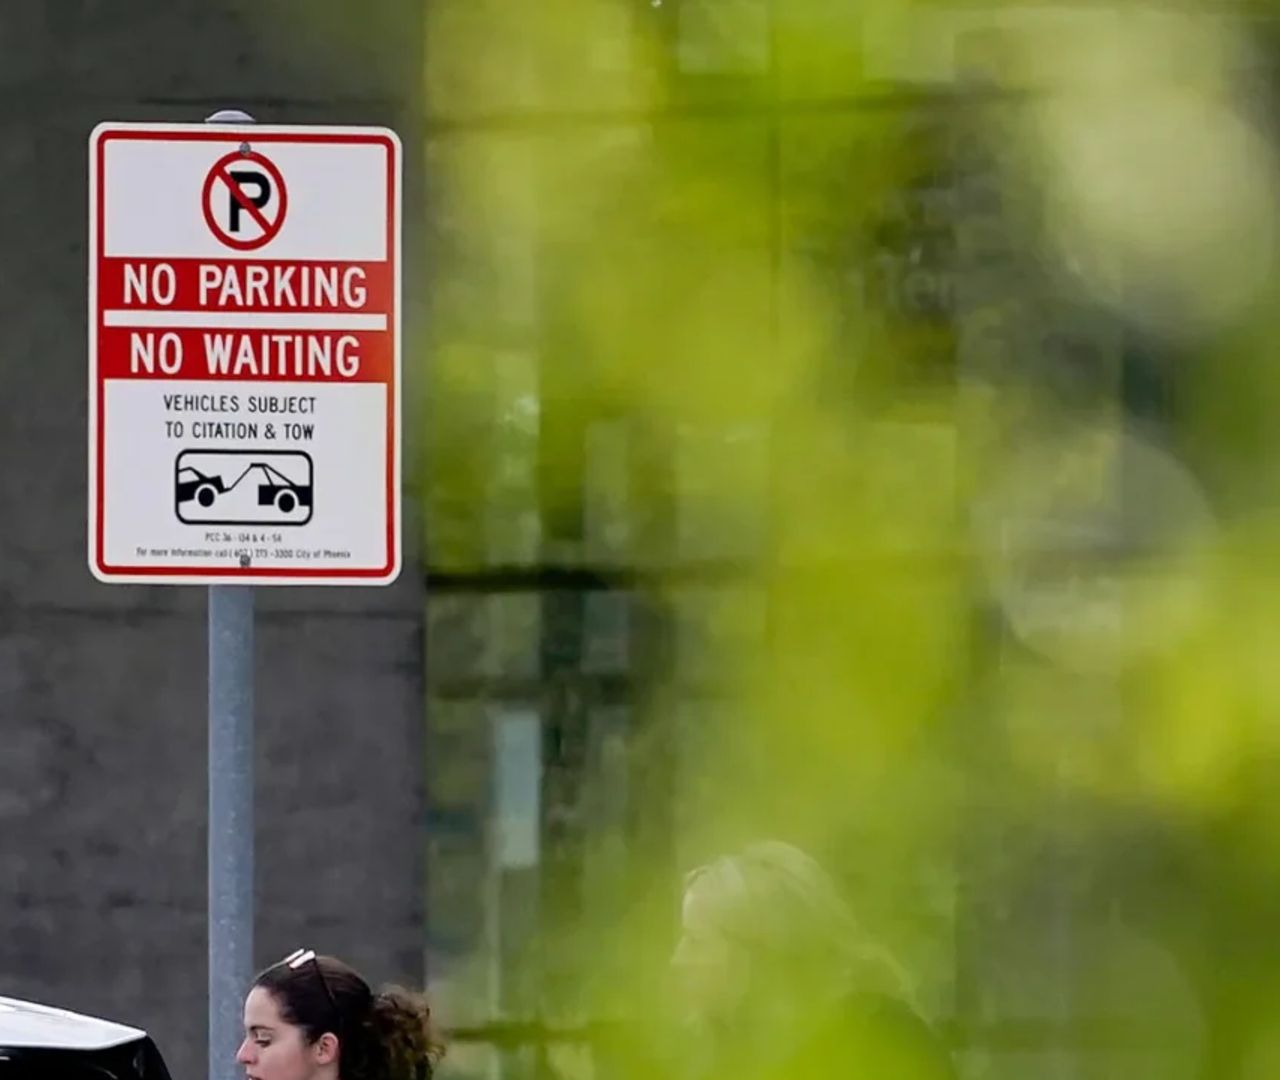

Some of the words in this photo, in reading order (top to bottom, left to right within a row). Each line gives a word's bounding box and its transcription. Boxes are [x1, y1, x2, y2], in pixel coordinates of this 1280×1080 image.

[123, 263, 177, 306] NO
[198, 264, 368, 309] PARKING
[130, 332, 184, 375] NO
[203, 333, 361, 378] WAITING
[163, 394, 240, 412] VEHICLES
[247, 396, 317, 413] SUBJECT
[165, 420, 184, 438] TO
[192, 421, 258, 440] CITATION
[264, 422, 276, 440] &
[284, 423, 315, 440] TOW
